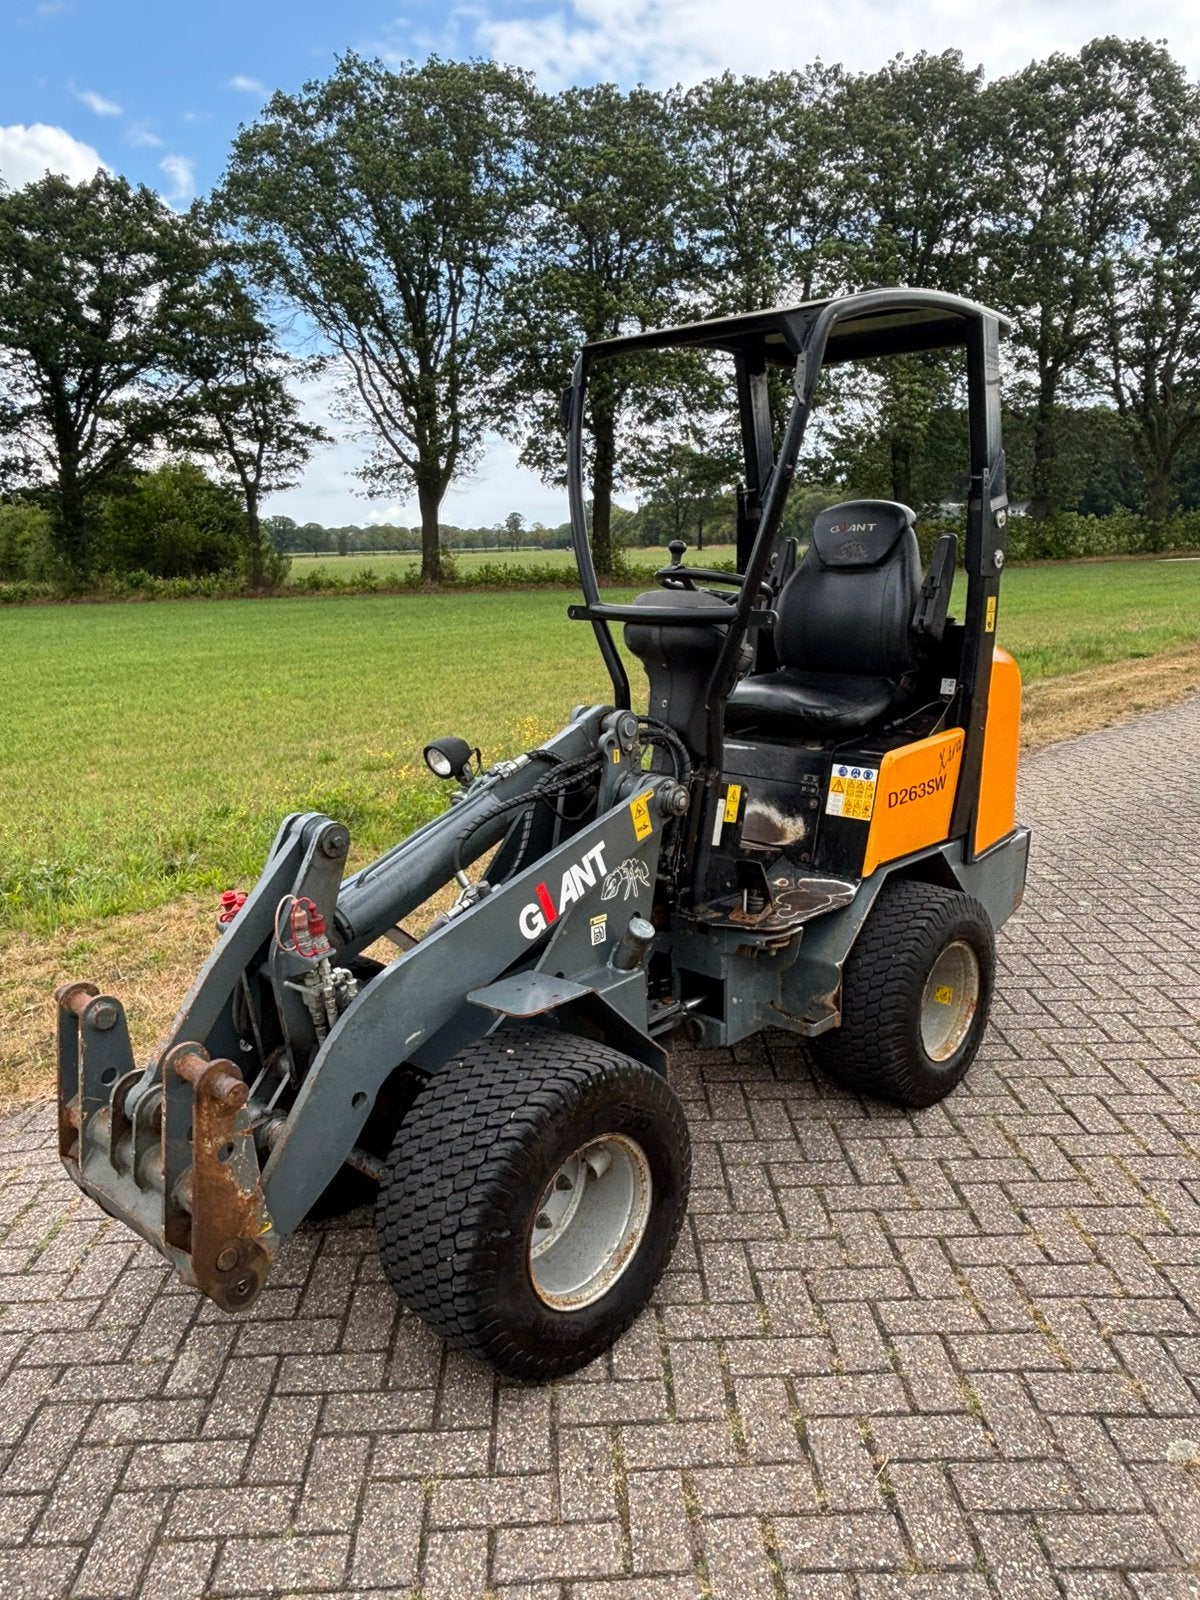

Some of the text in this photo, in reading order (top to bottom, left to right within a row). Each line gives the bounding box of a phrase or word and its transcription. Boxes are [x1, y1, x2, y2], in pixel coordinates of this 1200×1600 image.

[830, 522, 877, 533] GIANT
[888, 774, 947, 809] D263SW
[518, 839, 607, 940] GIANT
